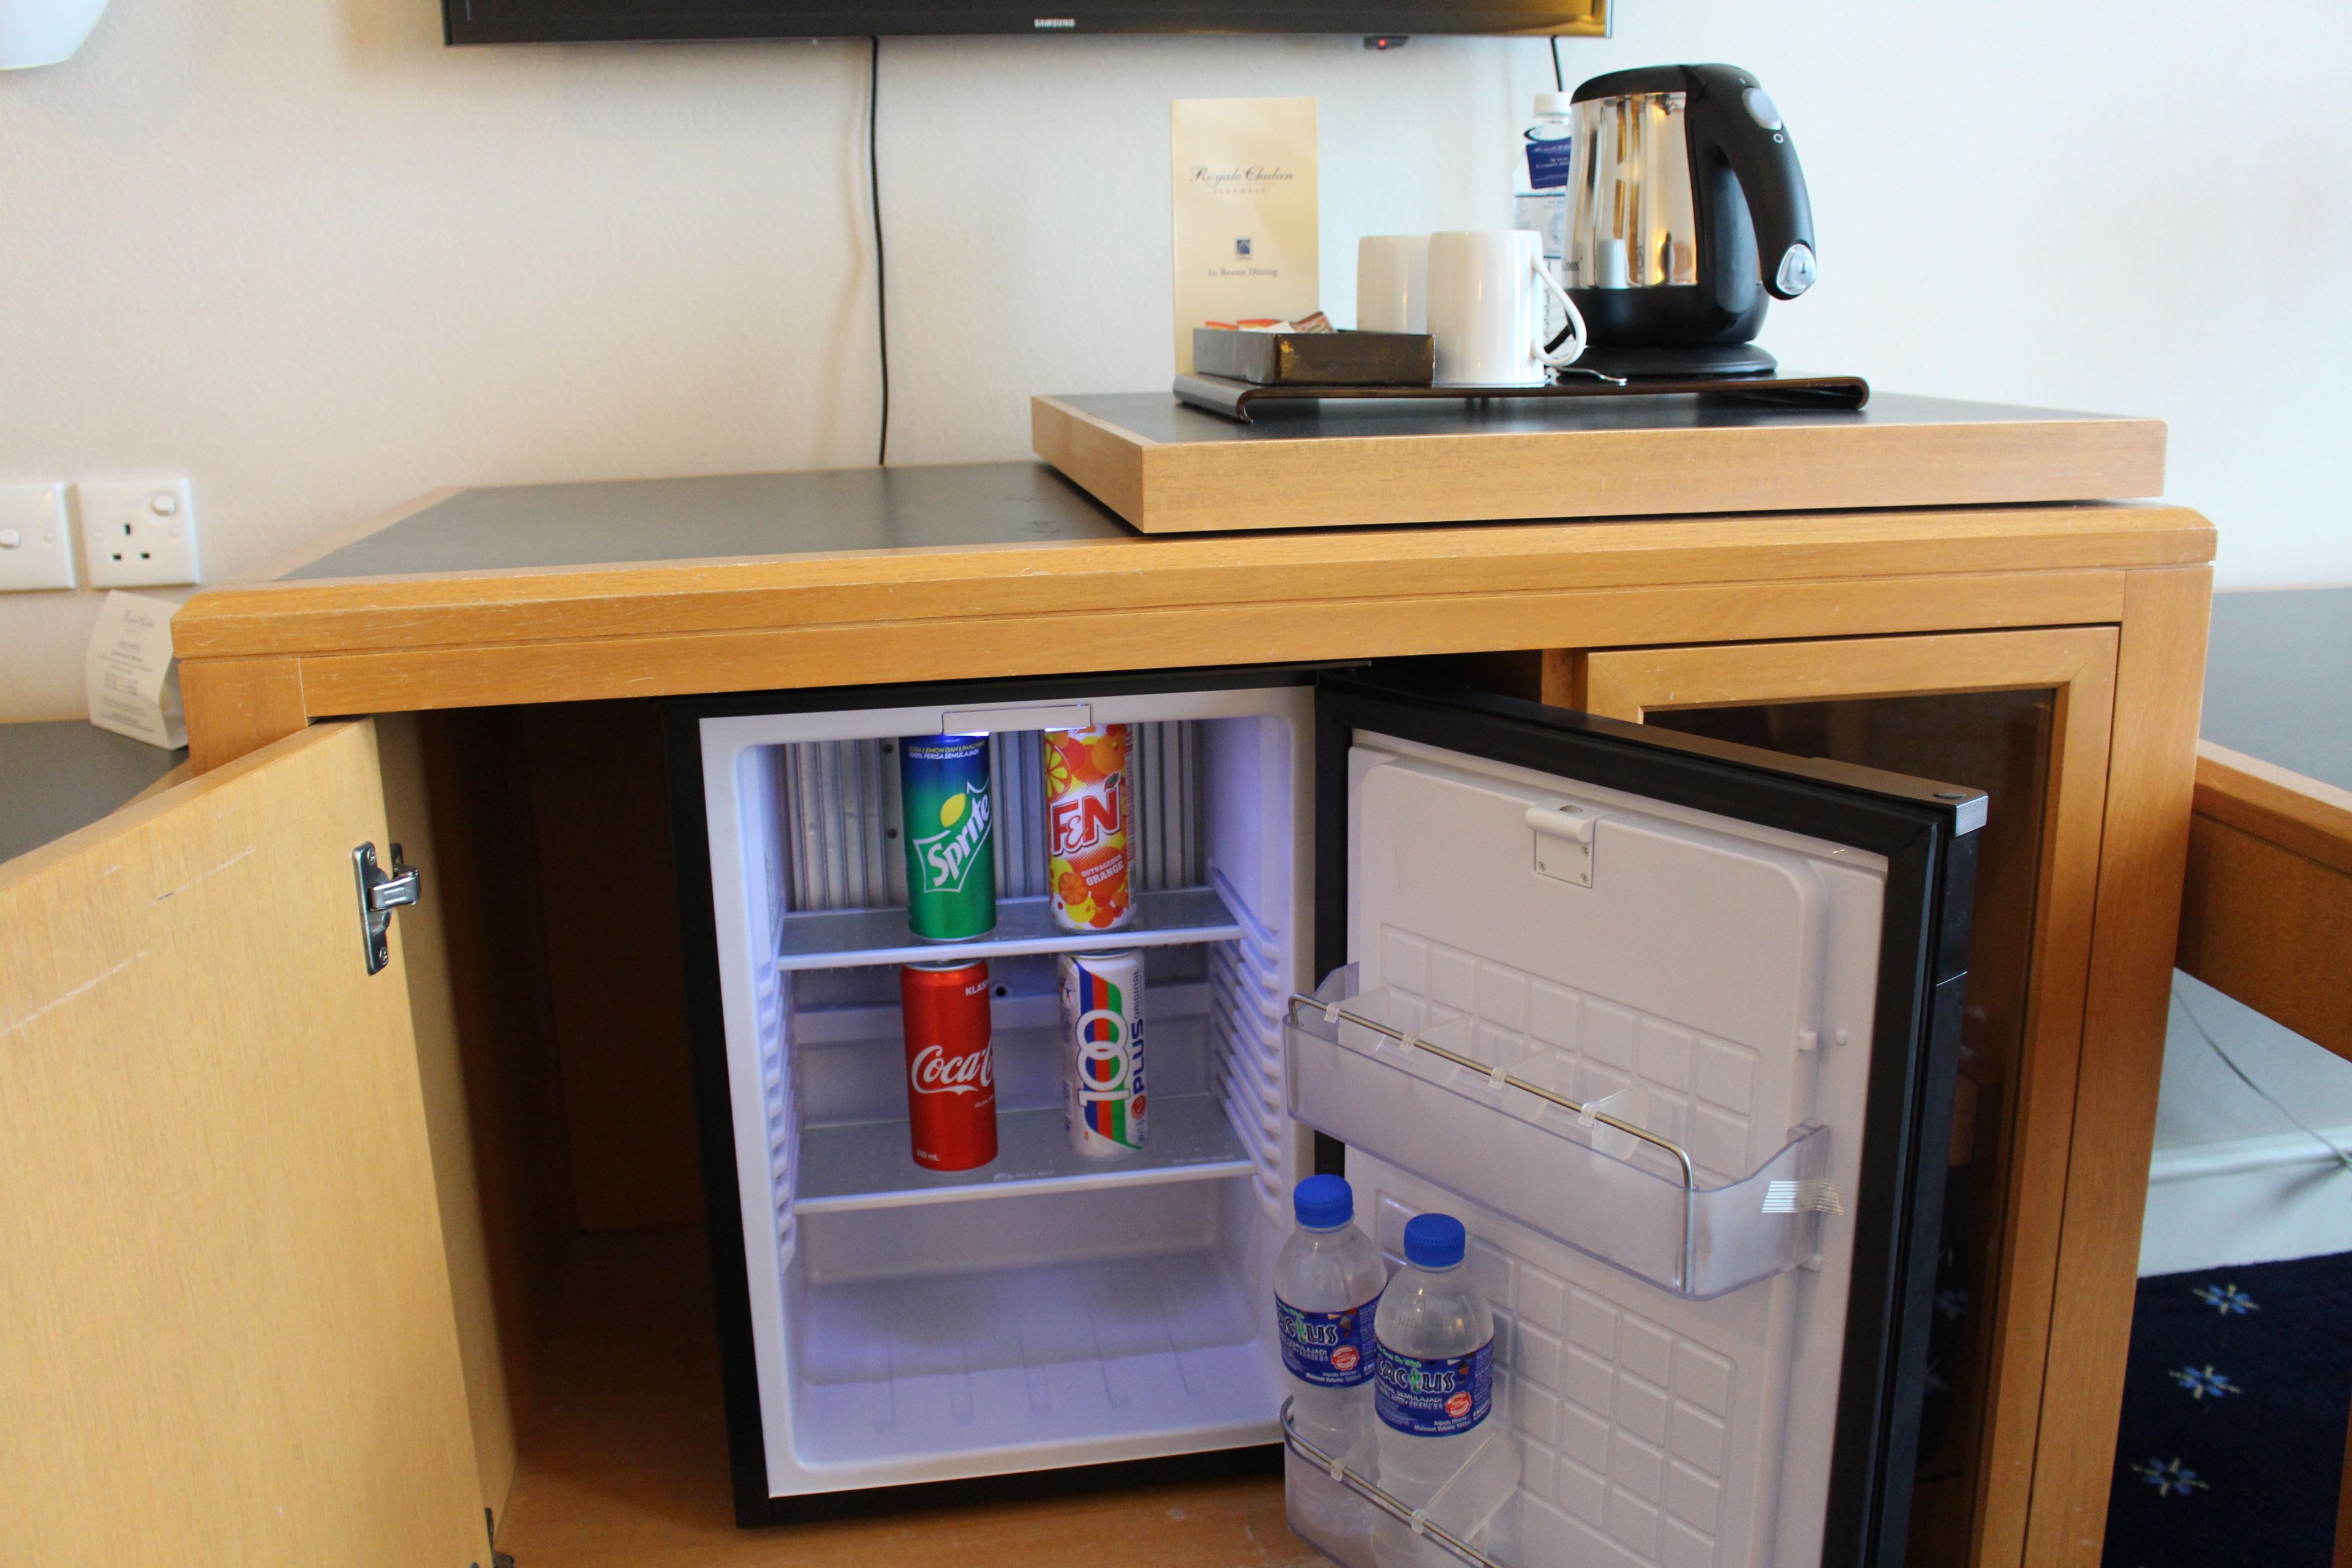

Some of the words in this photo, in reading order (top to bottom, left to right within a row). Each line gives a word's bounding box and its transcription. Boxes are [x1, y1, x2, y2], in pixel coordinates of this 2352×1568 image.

[1189, 165, 1242, 184] Royale
[1244, 165, 1294, 182] Chulan
[1208, 268, 1218, 276] In
[1220, 268, 1246, 276] Room
[1249, 268, 1278, 278] Dining
[927, 794, 990, 888] Sprite
[1086, 861, 1125, 887] ORANGE
[1075, 1009, 1131, 1108] 100
[1131, 1019, 1145, 1095] PLUS
